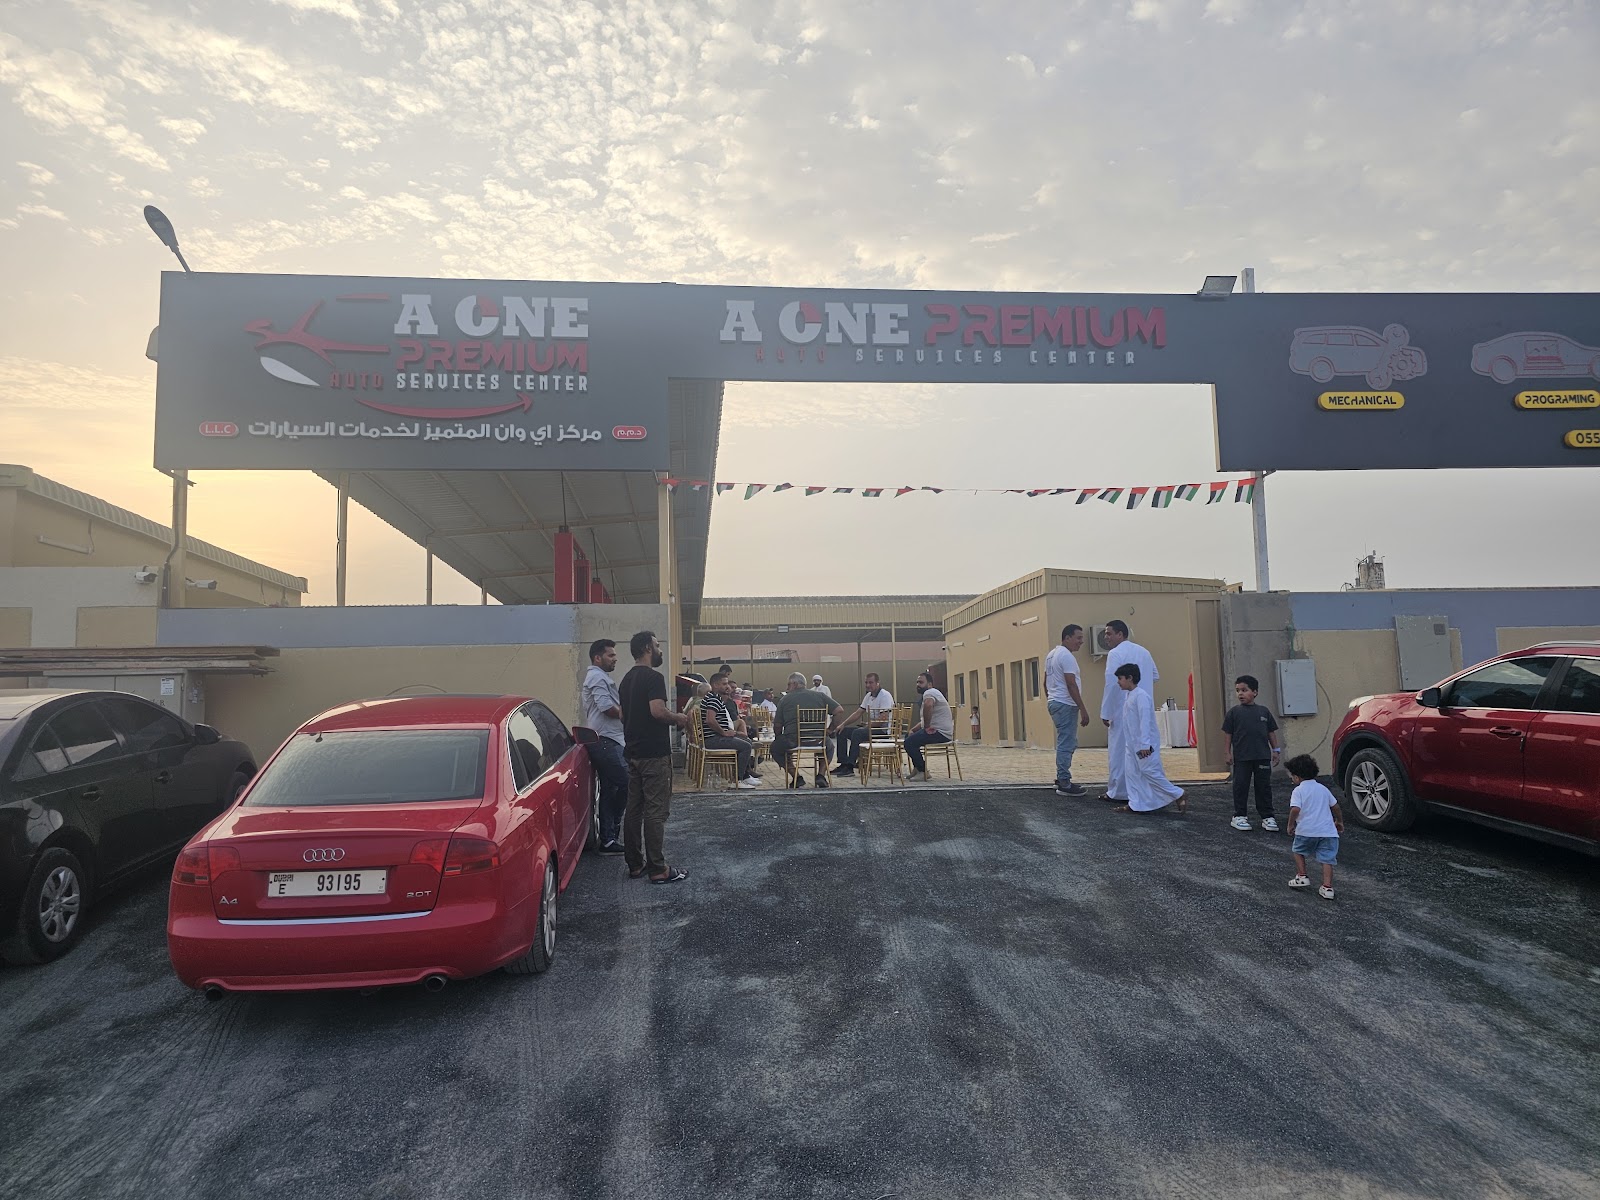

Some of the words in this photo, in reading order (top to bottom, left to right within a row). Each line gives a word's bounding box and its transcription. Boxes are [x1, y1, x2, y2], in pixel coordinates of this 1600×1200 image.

[394, 294, 439, 335] A
[455, 295, 589, 338] ONE
[719, 300, 763, 342] A
[778, 301, 910, 344] ONE
[924, 303, 1167, 347] PREMIUM
[395, 339, 589, 373] PREMIUM
[756, 348, 826, 361] AUTO
[855, 348, 1002, 363] SERVICES
[1030, 350, 1135, 365] CENTER
[330, 371, 384, 389] AUTO
[396, 372, 500, 390] SERVICES
[513, 374, 589, 391] CENTER
[1328, 395, 1397, 406] MECHANICAL
[1525, 394, 1595, 404] PROGRAMING
[205, 423, 231, 434] L.L.C
[248, 420, 335, 439] السيارات
[338, 421, 420, 438] لخدمات
[424, 423, 491, 441] المتميز
[495, 423, 526, 442] وان
[530, 424, 552, 446] اي
[557, 424, 602, 442] مركز
[278, 883, 287, 895] E
[317, 873, 361, 892] 93195
[219, 895, 239, 905] A4
